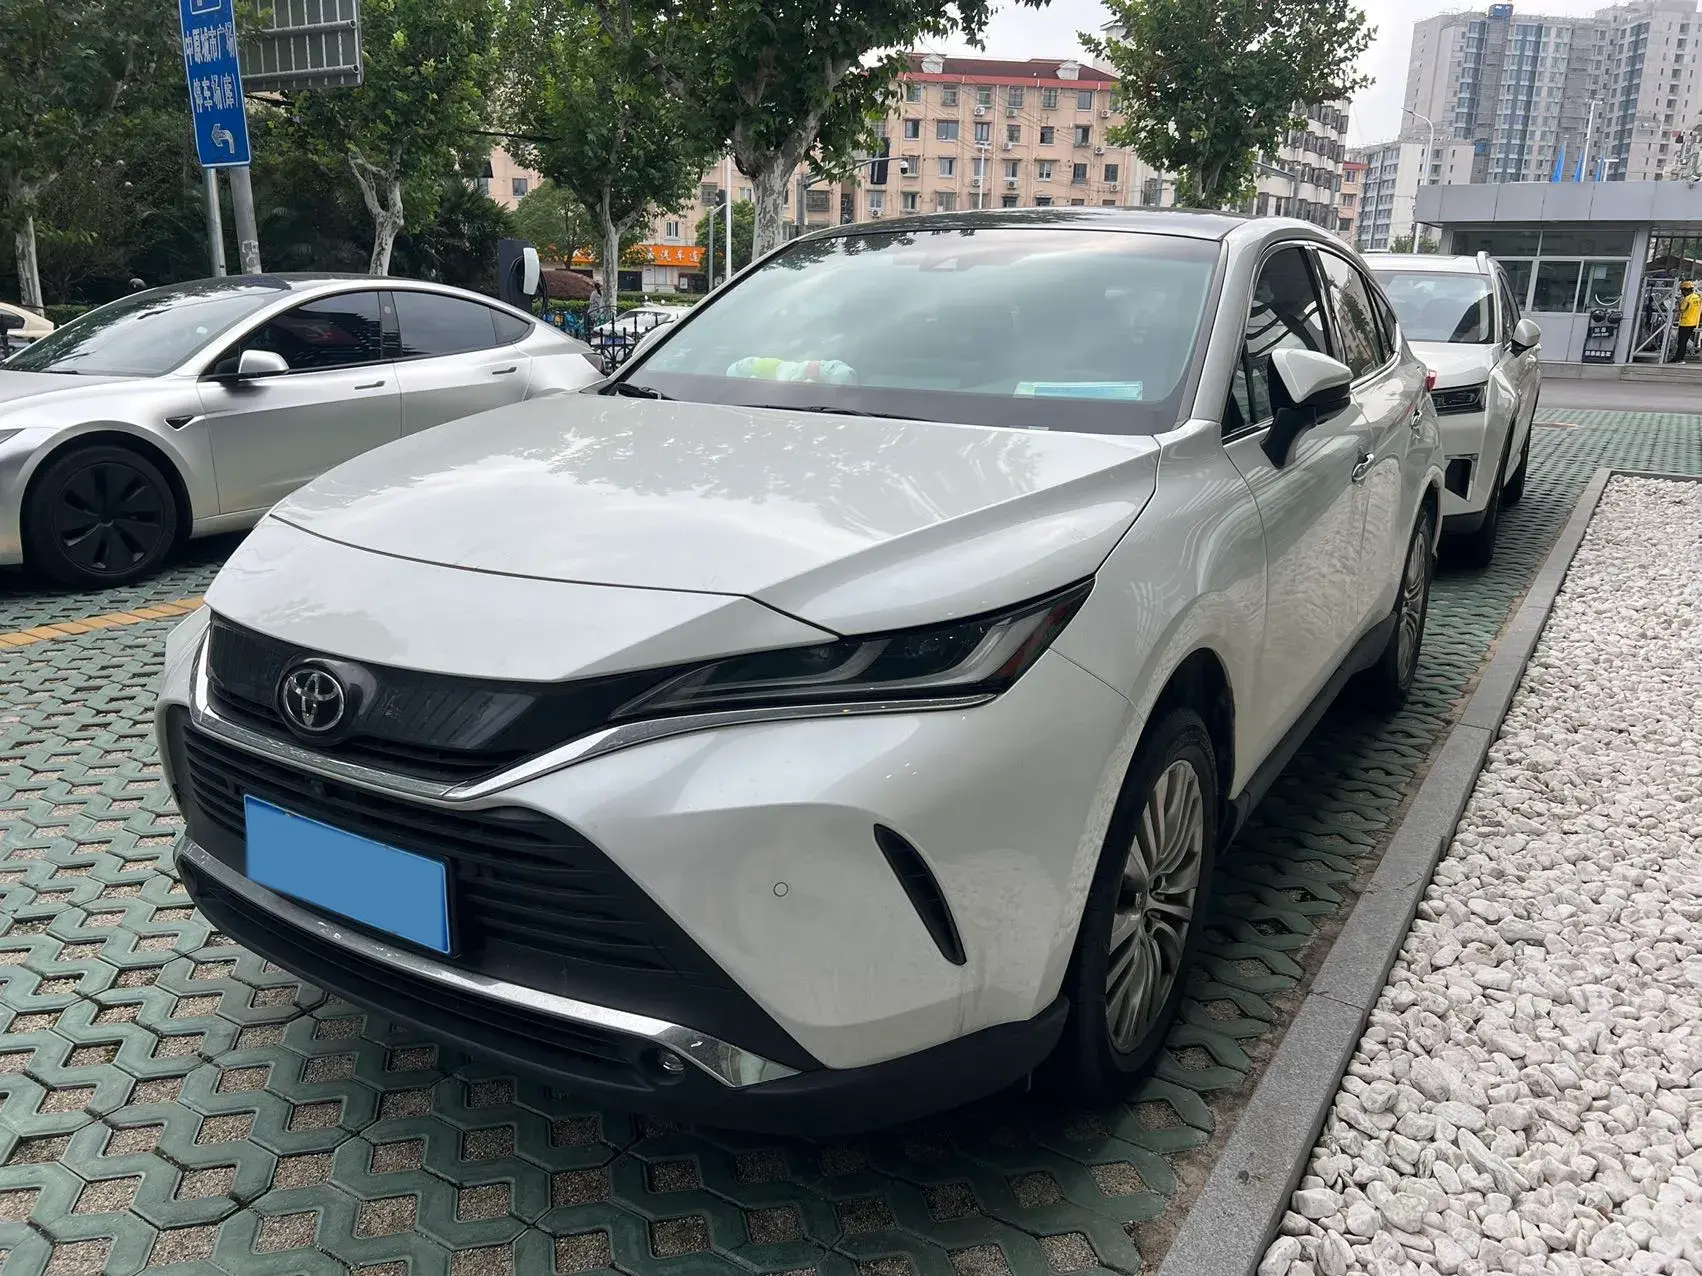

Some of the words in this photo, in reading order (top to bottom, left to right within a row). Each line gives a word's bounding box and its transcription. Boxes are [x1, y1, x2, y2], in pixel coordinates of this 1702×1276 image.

[184, 21, 235, 66] 中原城市广场
[193, 72, 238, 113] 停车场(库)
